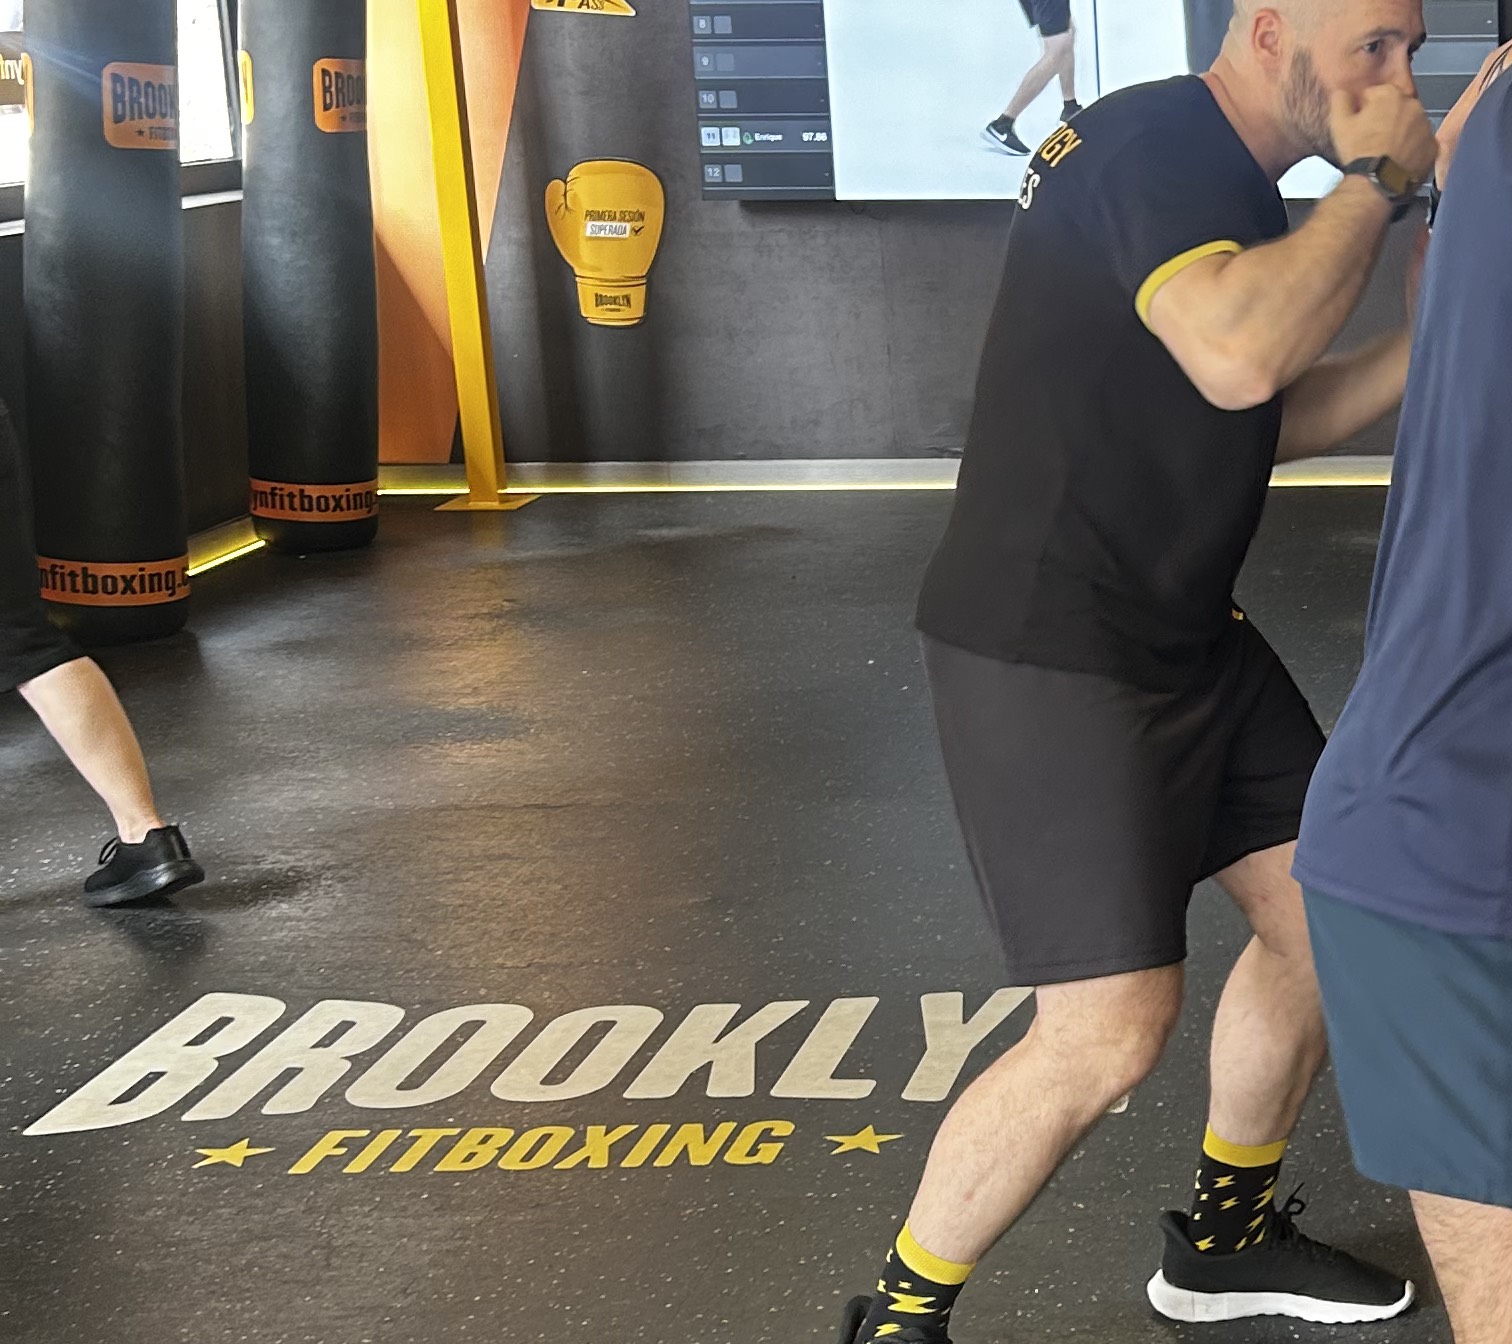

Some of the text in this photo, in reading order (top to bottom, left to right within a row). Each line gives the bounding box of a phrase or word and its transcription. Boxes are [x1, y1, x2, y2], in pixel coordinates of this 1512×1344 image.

[702, 94, 715, 104] 10
[707, 168, 720, 177] 12
[22, 987, 1036, 1136] BROOKLY
[288, 1121, 786, 1175] FITBOXING
